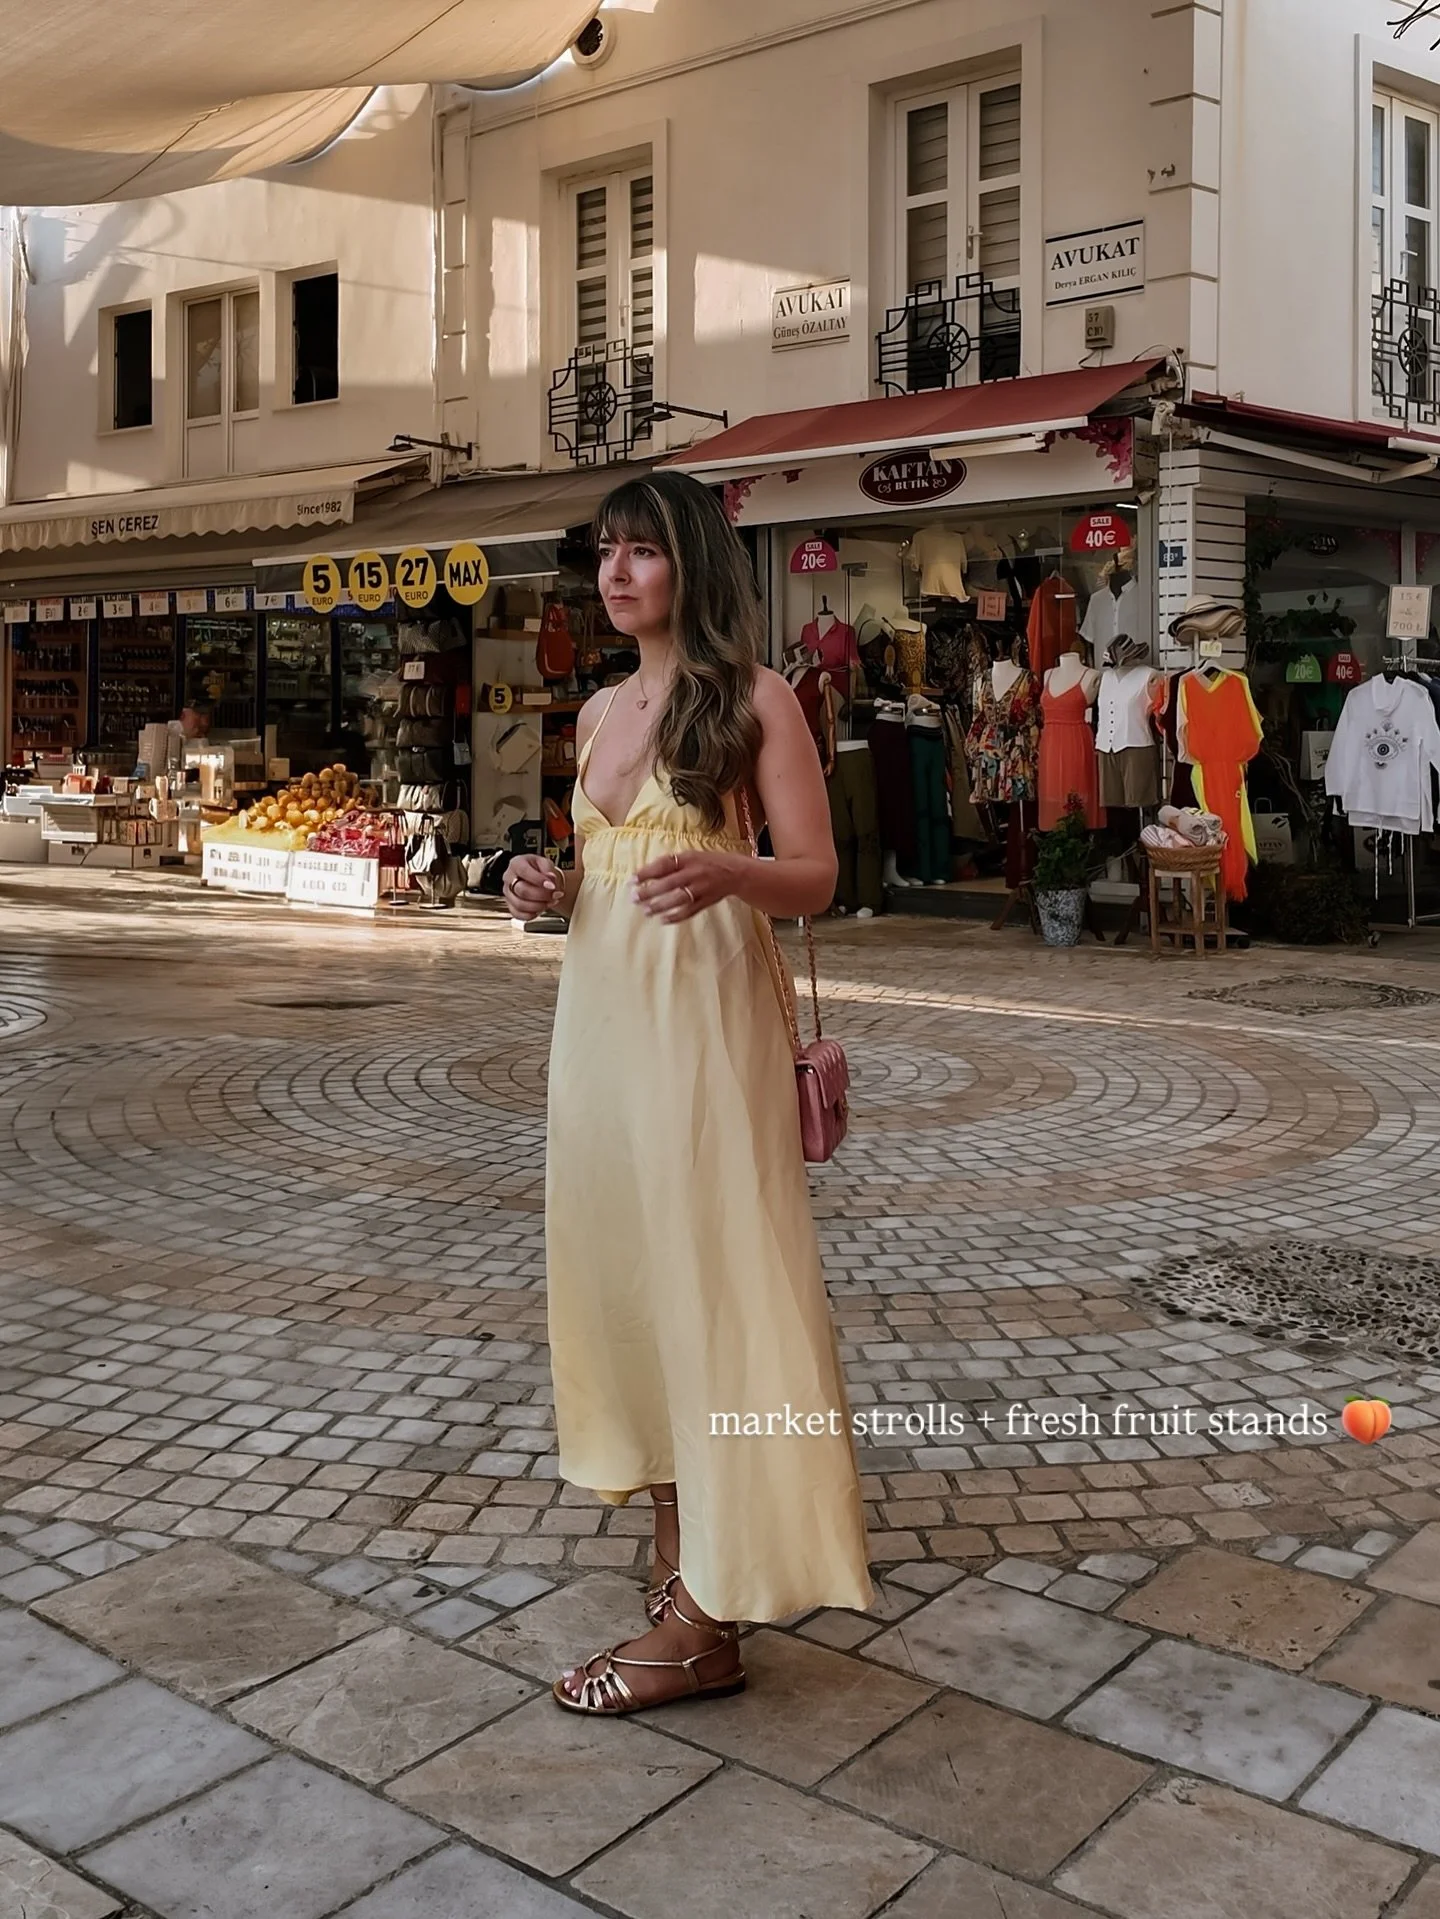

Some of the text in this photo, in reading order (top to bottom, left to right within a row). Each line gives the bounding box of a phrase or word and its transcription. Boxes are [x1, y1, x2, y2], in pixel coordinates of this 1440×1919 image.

[1051, 237, 1140, 270] AVUKAT
[1055, 279, 1077, 290] Derya
[1079, 271, 1109, 285] ERGAN
[775, 286, 847, 319] AVUKAT
[773, 316, 848, 340] Güneş ÖZALTAY
[872, 460, 953, 483] KAFTAN
[91, 514, 159, 540] ŞEN ÇEREZ
[1085, 530, 1117, 548] 40€
[400, 557, 429, 587] 27
[801, 553, 827, 570] 20€
[312, 564, 331, 594] 5
[354, 561, 383, 589] 15
[449, 559, 484, 588] MAX
[312, 596, 334, 606] EURO
[358, 593, 381, 603] EURO
[405, 590, 429, 601] EURO
[1336, 665, 1354, 679] 40€
[494, 688, 506, 705] 5
